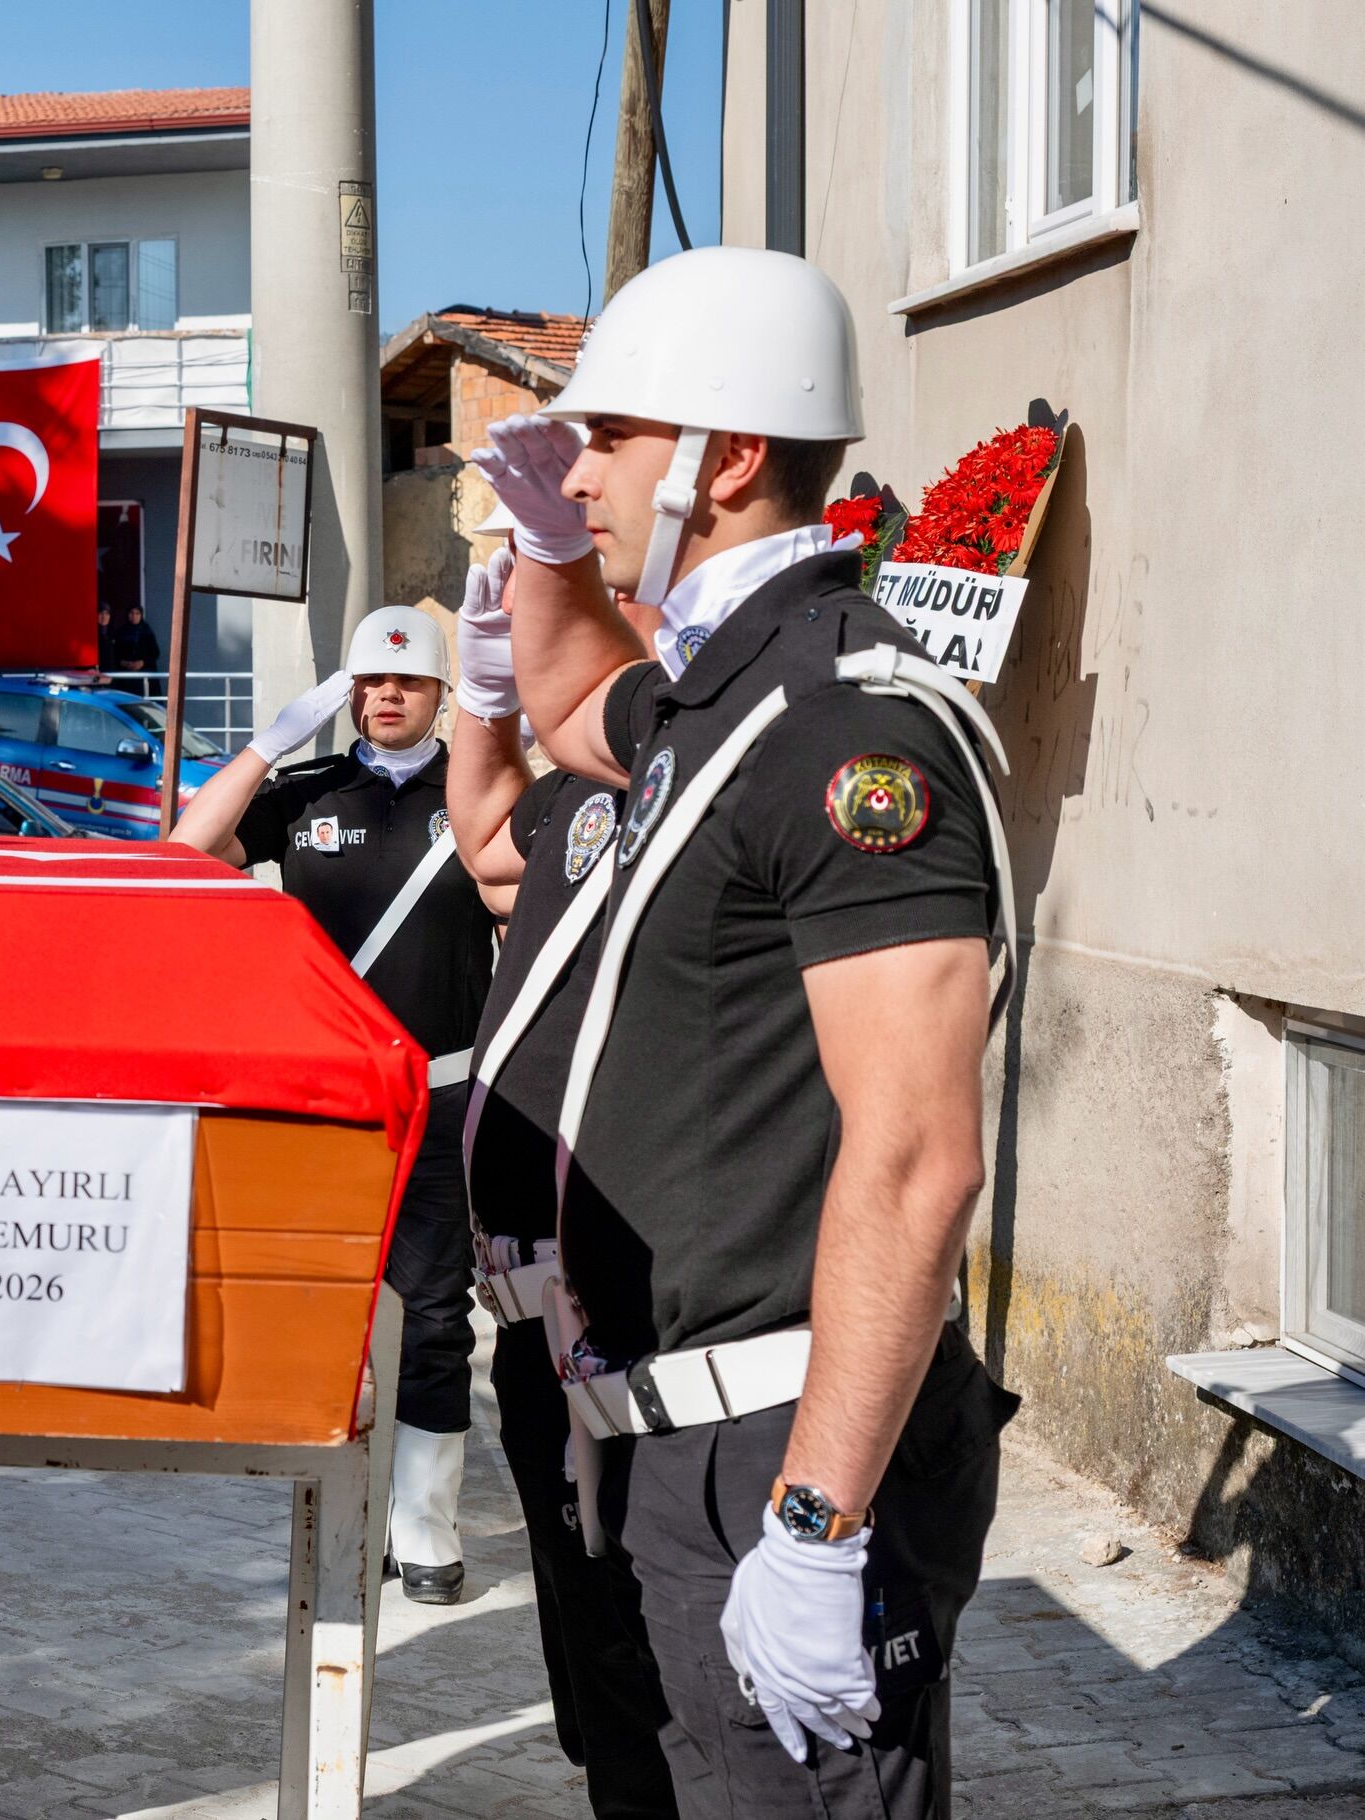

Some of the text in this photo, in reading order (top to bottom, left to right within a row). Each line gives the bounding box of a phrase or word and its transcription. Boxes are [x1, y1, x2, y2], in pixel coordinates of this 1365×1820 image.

[876, 574, 902, 606] ET
[294, 828, 367, 851] ÇEV VVET
